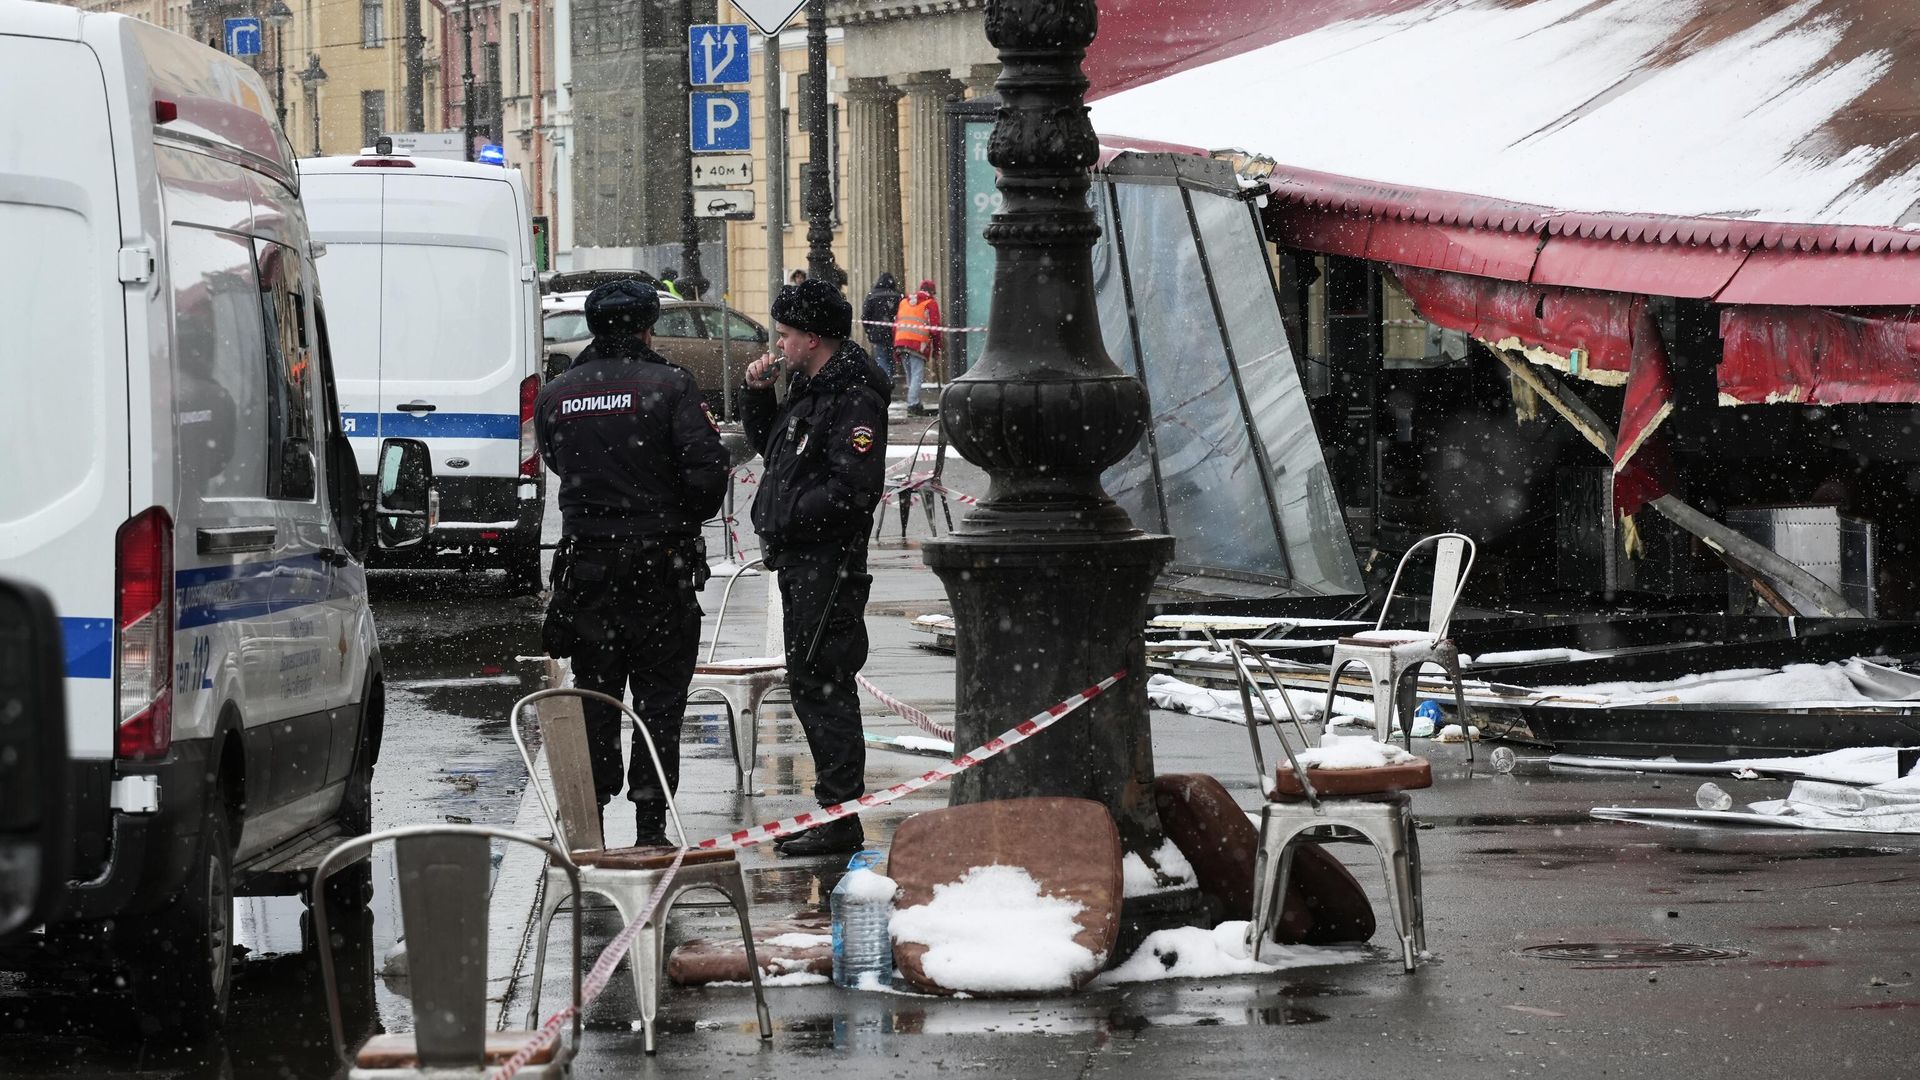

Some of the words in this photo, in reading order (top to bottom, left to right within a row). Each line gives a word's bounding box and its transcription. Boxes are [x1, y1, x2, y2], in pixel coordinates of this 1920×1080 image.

[706, 98, 739, 145] P
[562, 394, 632, 415] ПОЛИЦИЯ
[192, 635, 213, 691] 112
